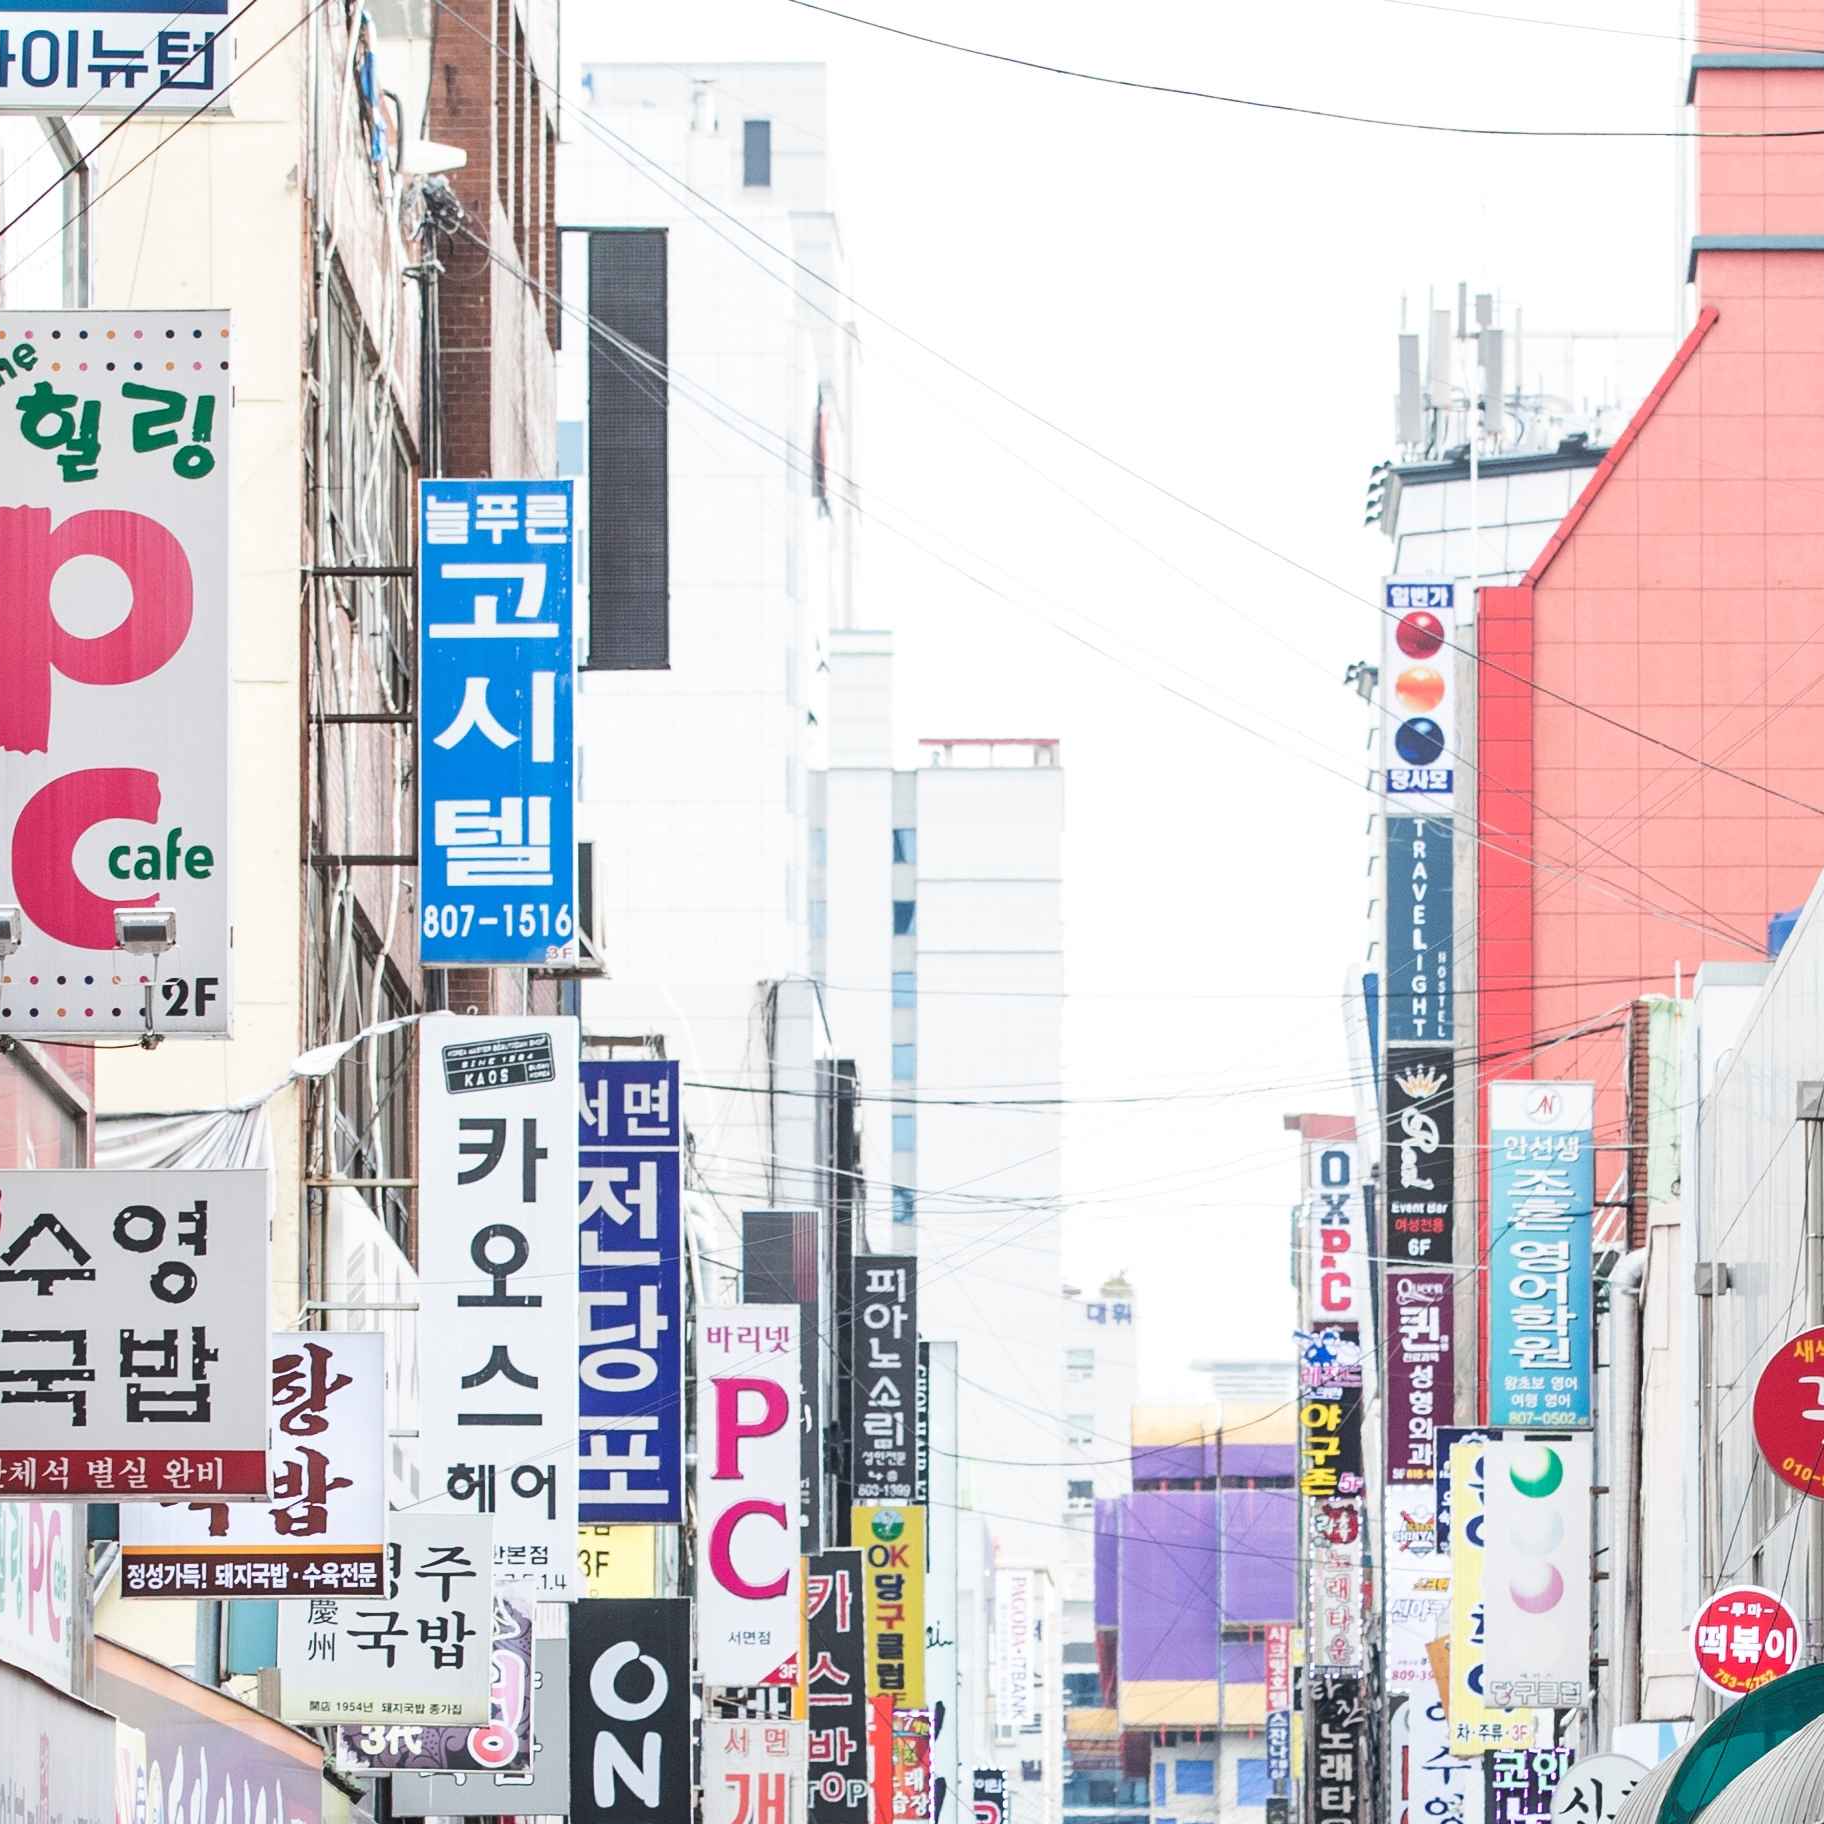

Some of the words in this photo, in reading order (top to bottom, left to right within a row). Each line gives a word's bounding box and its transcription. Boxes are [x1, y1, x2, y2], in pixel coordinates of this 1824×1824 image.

[17, 381, 215, 482] 힐링
[426, 494, 571, 547] 늘푸른
[429, 562, 560, 886] 고시텔
[107, 828, 215, 881] cafe
[423, 905, 573, 938] 807-1516
[1410, 818, 1428, 1038] TRAVELIGHT
[162, 978, 218, 1018] 2F
[1437, 951, 1447, 1038] HOSTEL
[465, 1069, 509, 1087] KAOS
[1504, 1136, 1580, 1161] 안선생
[1408, 1238, 1431, 1255] 6F
[457, 1117, 548, 1426] 카오스
[1508, 1240, 1578, 1370] 영어학원
[578, 1161, 670, 1507] 전당포
[706, 1326, 790, 1354] 바리넷
[1545, 1393, 1571, 1408] 영어
[1551, 1376, 1578, 1391] 영어
[85, 1459, 148, 1491] 별실
[162, 1459, 225, 1491] 완비
[448, 1463, 557, 1520] 헤어
[708, 1378, 790, 1600] PC
[127, 1565, 207, 1590] 정성가득!
[215, 1563, 288, 1589] 돼지국밥
[302, 1562, 377, 1588] 수육전문
[868, 1544, 909, 1568] OK
[1325, 1552, 1353, 1665] 노래타운
[346, 1609, 476, 1669] 국밥
[728, 1631, 771, 1647] 서면점
[874, 1573, 907, 1690] 당구클럽
[1699, 1626, 1794, 1664] 떡볶이
[336, 1701, 374, 1714] 1954년
[725, 1728, 789, 1756] 서면
